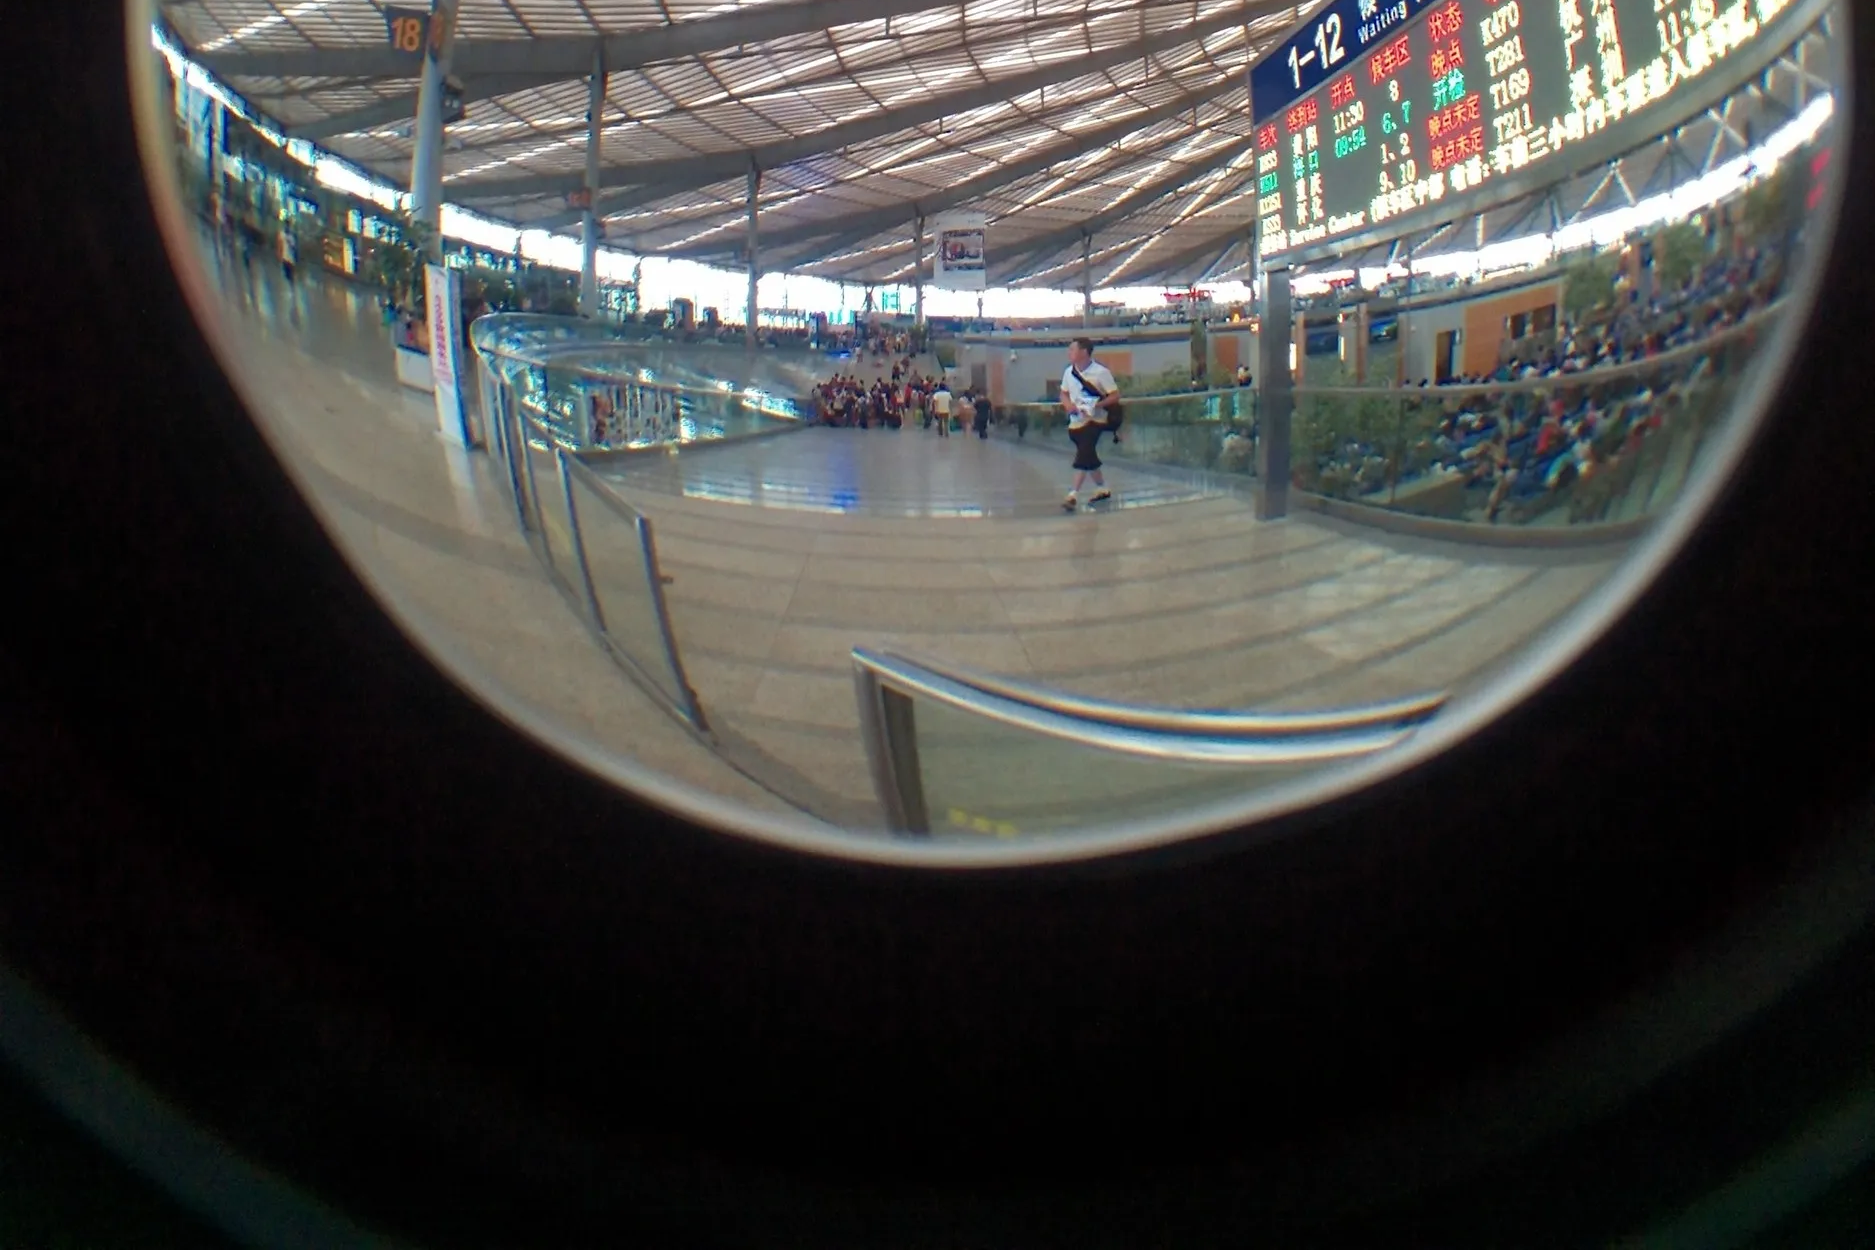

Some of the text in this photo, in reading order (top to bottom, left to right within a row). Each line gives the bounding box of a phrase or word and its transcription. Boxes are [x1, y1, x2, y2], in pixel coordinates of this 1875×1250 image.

[391, 16, 421, 52] 18
[1358, 0, 1407, 43] Waiting
[1480, 1, 1520, 47] K470
[1288, 13, 1345, 89] 1-12
[1330, 75, 1355, 109] 开点
[1369, 35, 1411, 84] 候车区
[1428, 1, 1463, 41] 状态
[1389, 80, 1399, 102] 8
[1430, 38, 1464, 78] 晚点
[1485, 35, 1525, 77] T281
[1490, 68, 1530, 110] T169
[1428, 94, 1481, 140] 晚点未定
[1493, 103, 1533, 143] T211
[1430, 126, 1484, 170] 晚点未定
